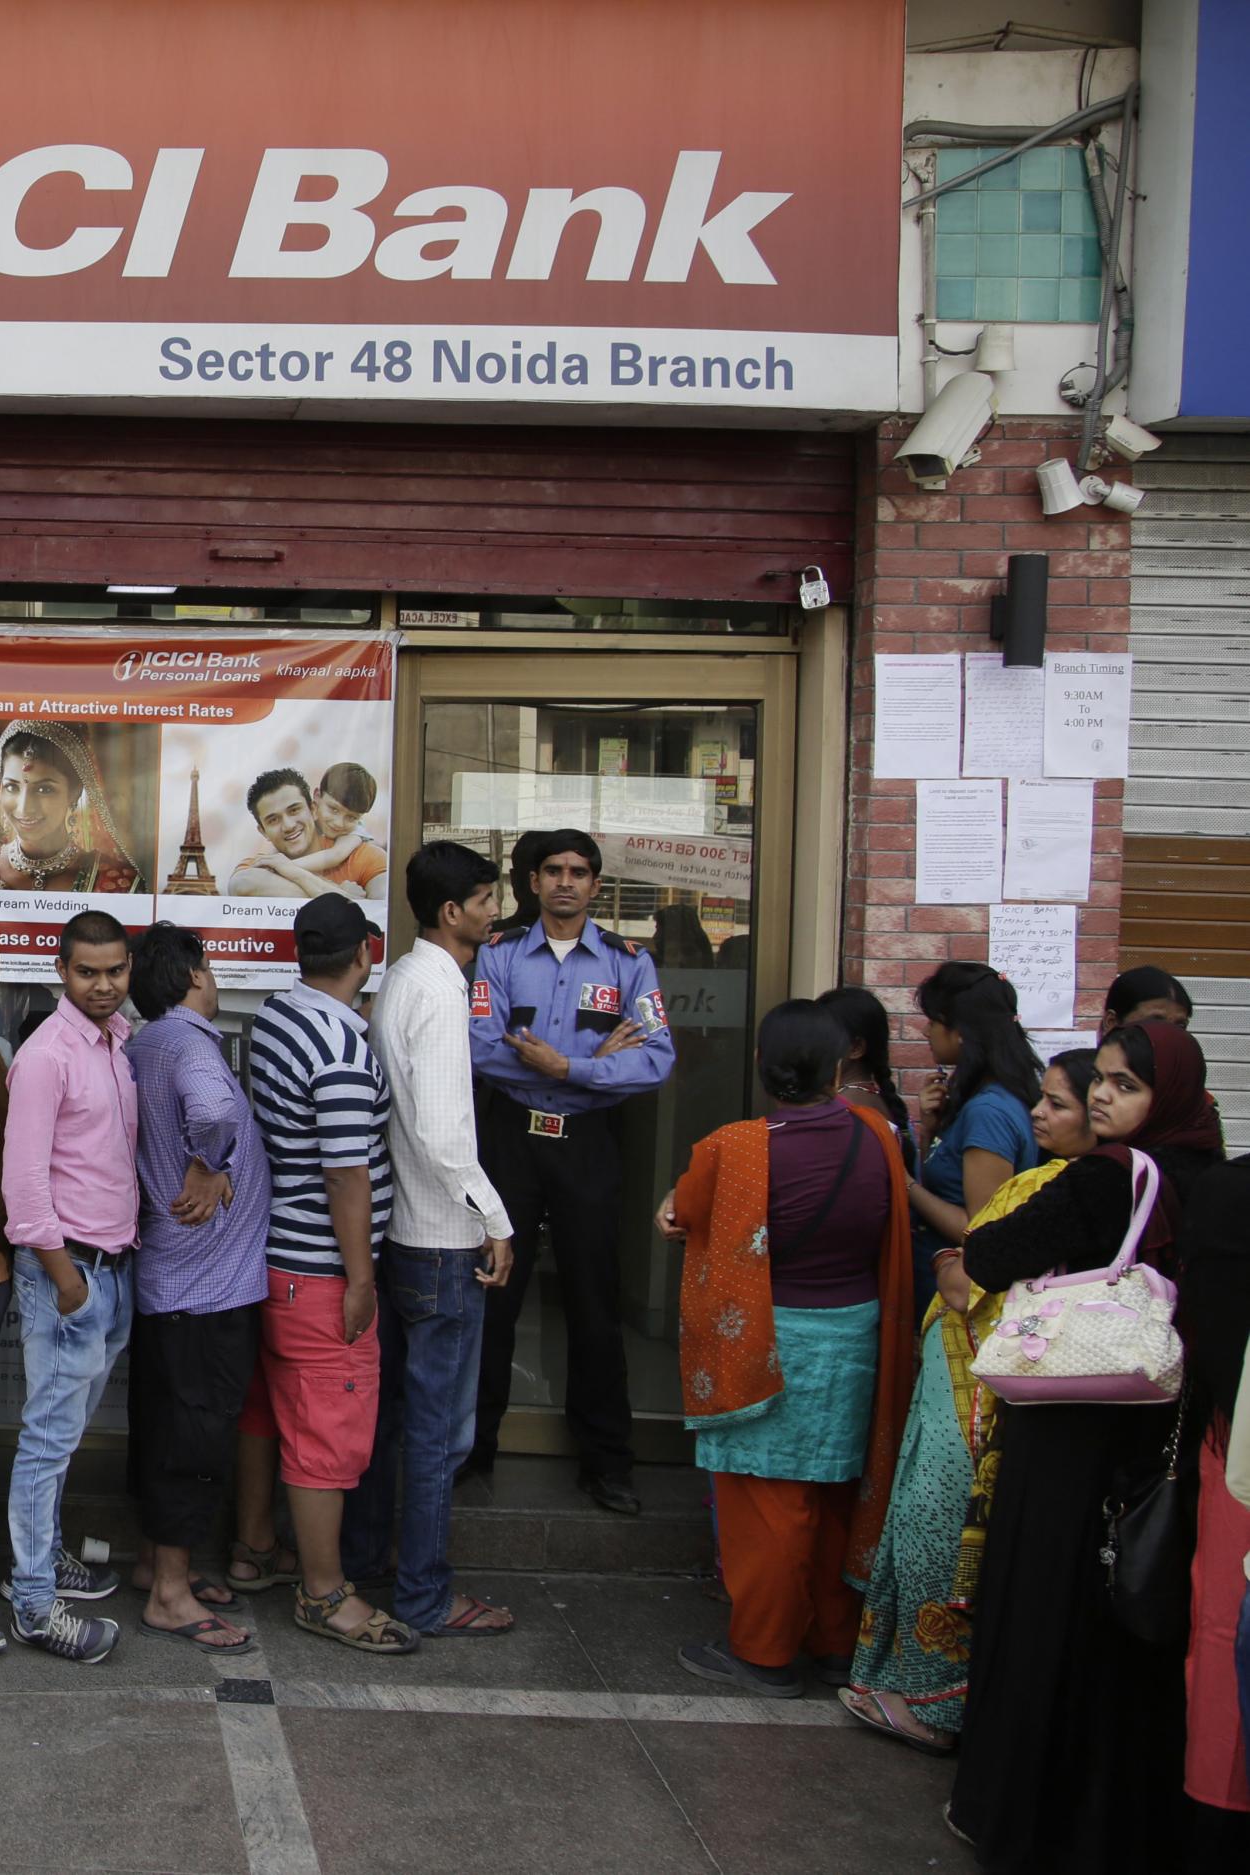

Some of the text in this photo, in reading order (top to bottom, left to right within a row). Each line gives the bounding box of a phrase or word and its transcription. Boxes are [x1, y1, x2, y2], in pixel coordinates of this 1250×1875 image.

[228, 147, 794, 285] Bank
[160, 337, 793, 390] Sector 48 Noida Branch
[143, 651, 261, 668] ICICI Bank
[140, 670, 261, 683] Personal Loans
[276, 664, 376, 680] khayaal aapka
[1054, 663, 1125, 675] Branch Timing
[19, 701, 35, 712] at
[39, 699, 118, 716] Attractive
[123, 702, 184, 717] Interest
[189, 704, 234, 718] Rates
[1078, 704, 1091, 714] To
[1087, 718, 1103, 728] PM
[35, 899, 89, 913] Wedding
[222, 904, 300, 917] Dream Vacat
[200, 937, 275, 953] xecutive
